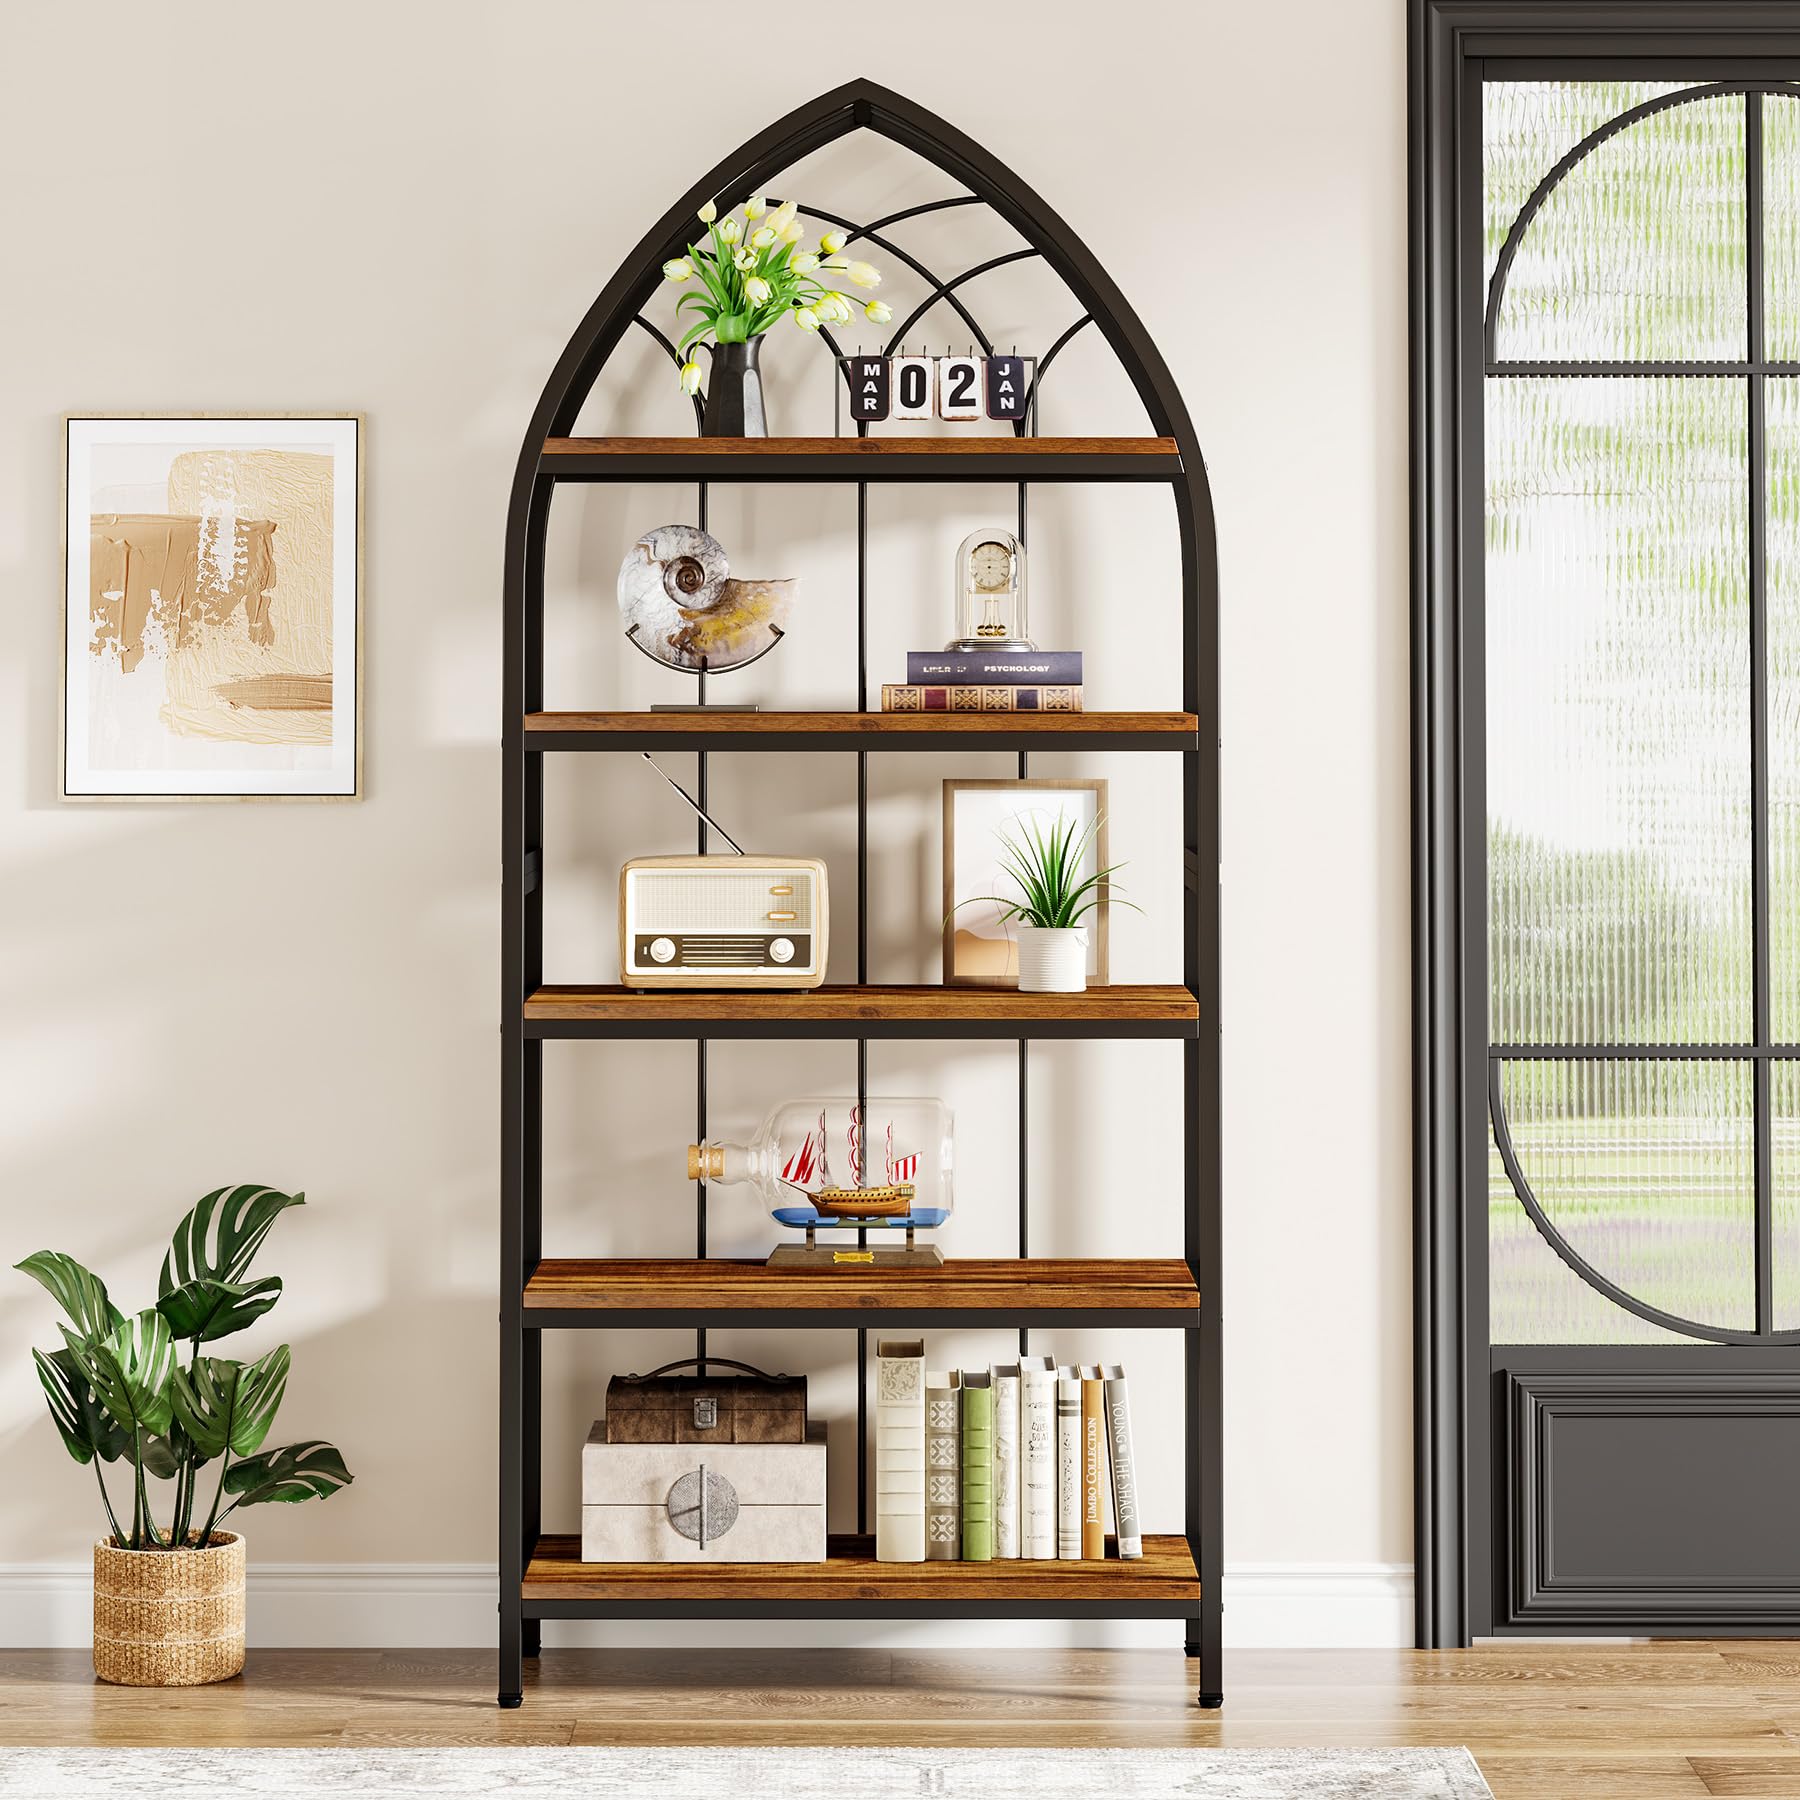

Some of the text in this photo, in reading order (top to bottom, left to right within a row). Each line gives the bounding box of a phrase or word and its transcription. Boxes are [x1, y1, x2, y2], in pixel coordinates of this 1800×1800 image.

[863, 364, 880, 410] MAR
[998, 363, 1015, 409] JAN
[1086, 1417, 1099, 1524] JUMBO COLLECTION
[1112, 1400, 1134, 1523] YOUNG THE SHACK
